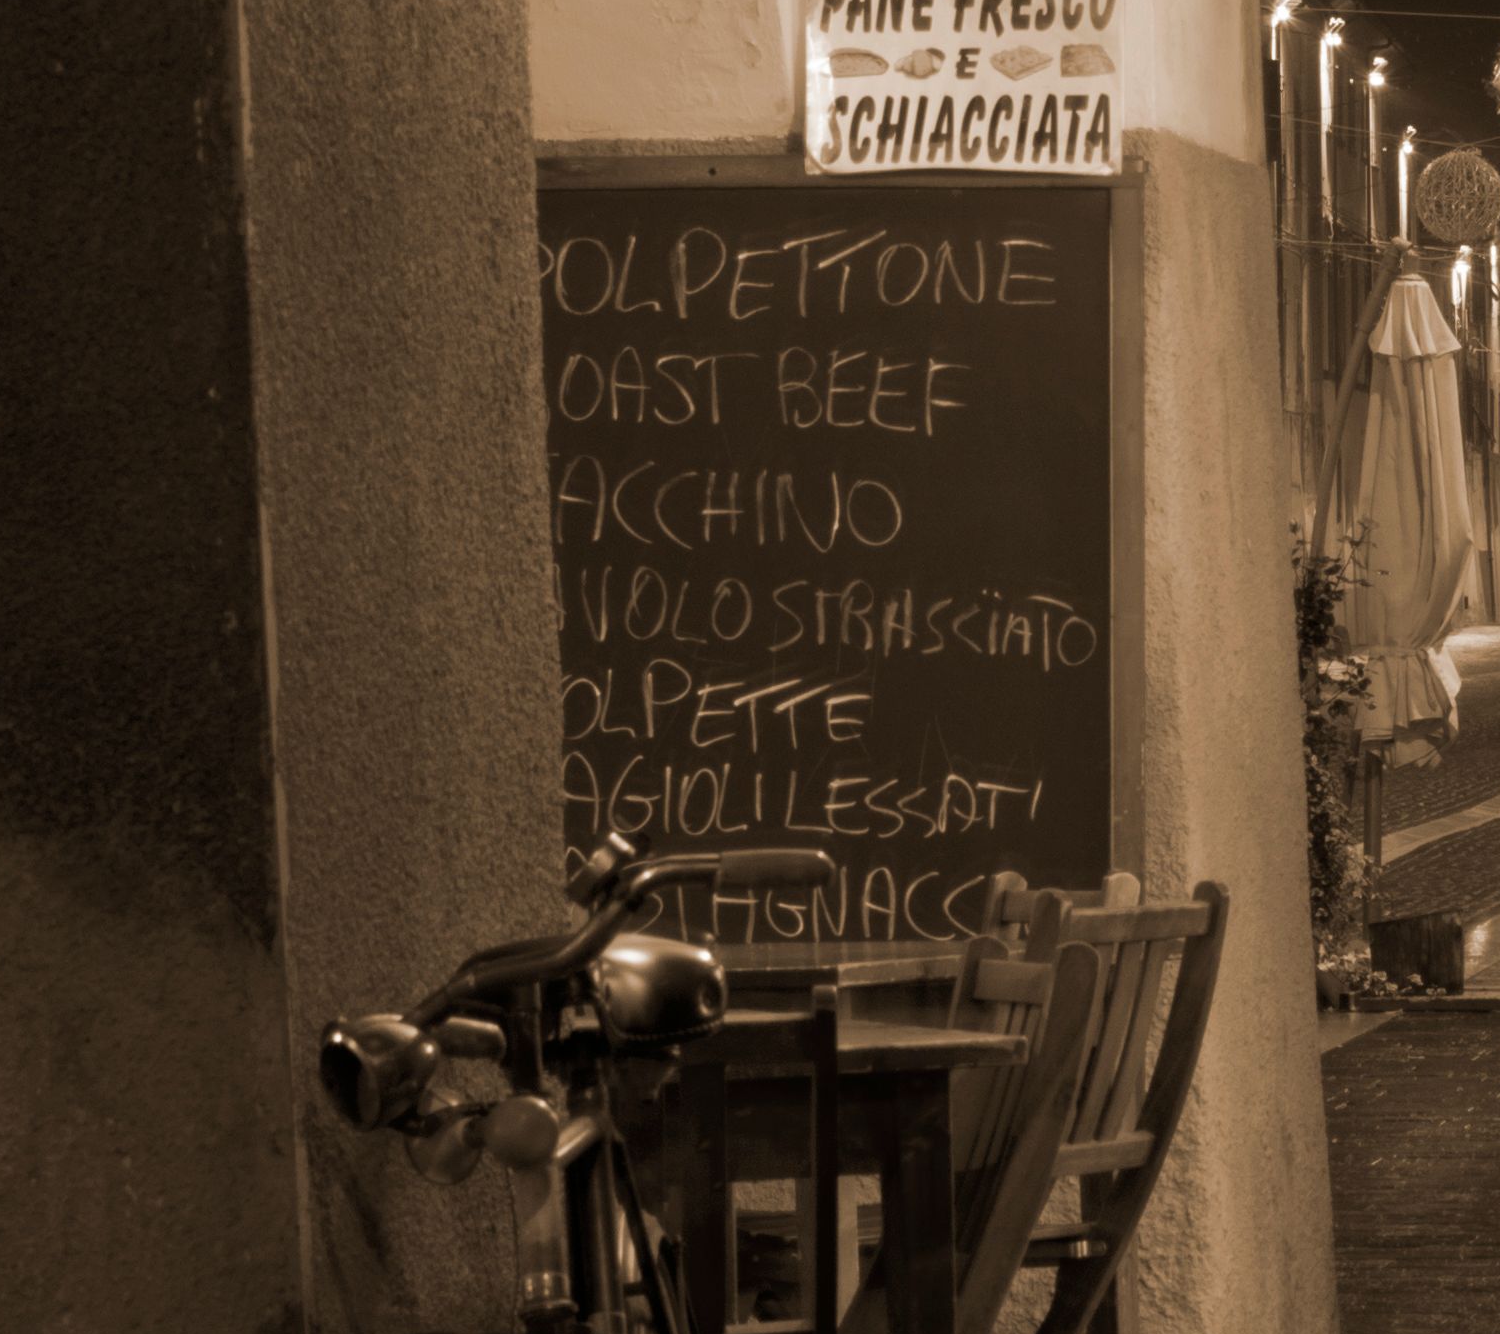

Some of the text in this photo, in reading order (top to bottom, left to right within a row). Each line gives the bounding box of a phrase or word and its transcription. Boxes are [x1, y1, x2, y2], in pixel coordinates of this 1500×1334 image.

[956, 48, 980, 80] E
[820, 94, 1111, 164] SCHIACCIATA
[559, 347, 971, 436] OAST BEEF
[551, 453, 901, 553] ACCHINO
[562, 658, 871, 753] OLPETTE
[563, 751, 763, 835] AGIOLI
